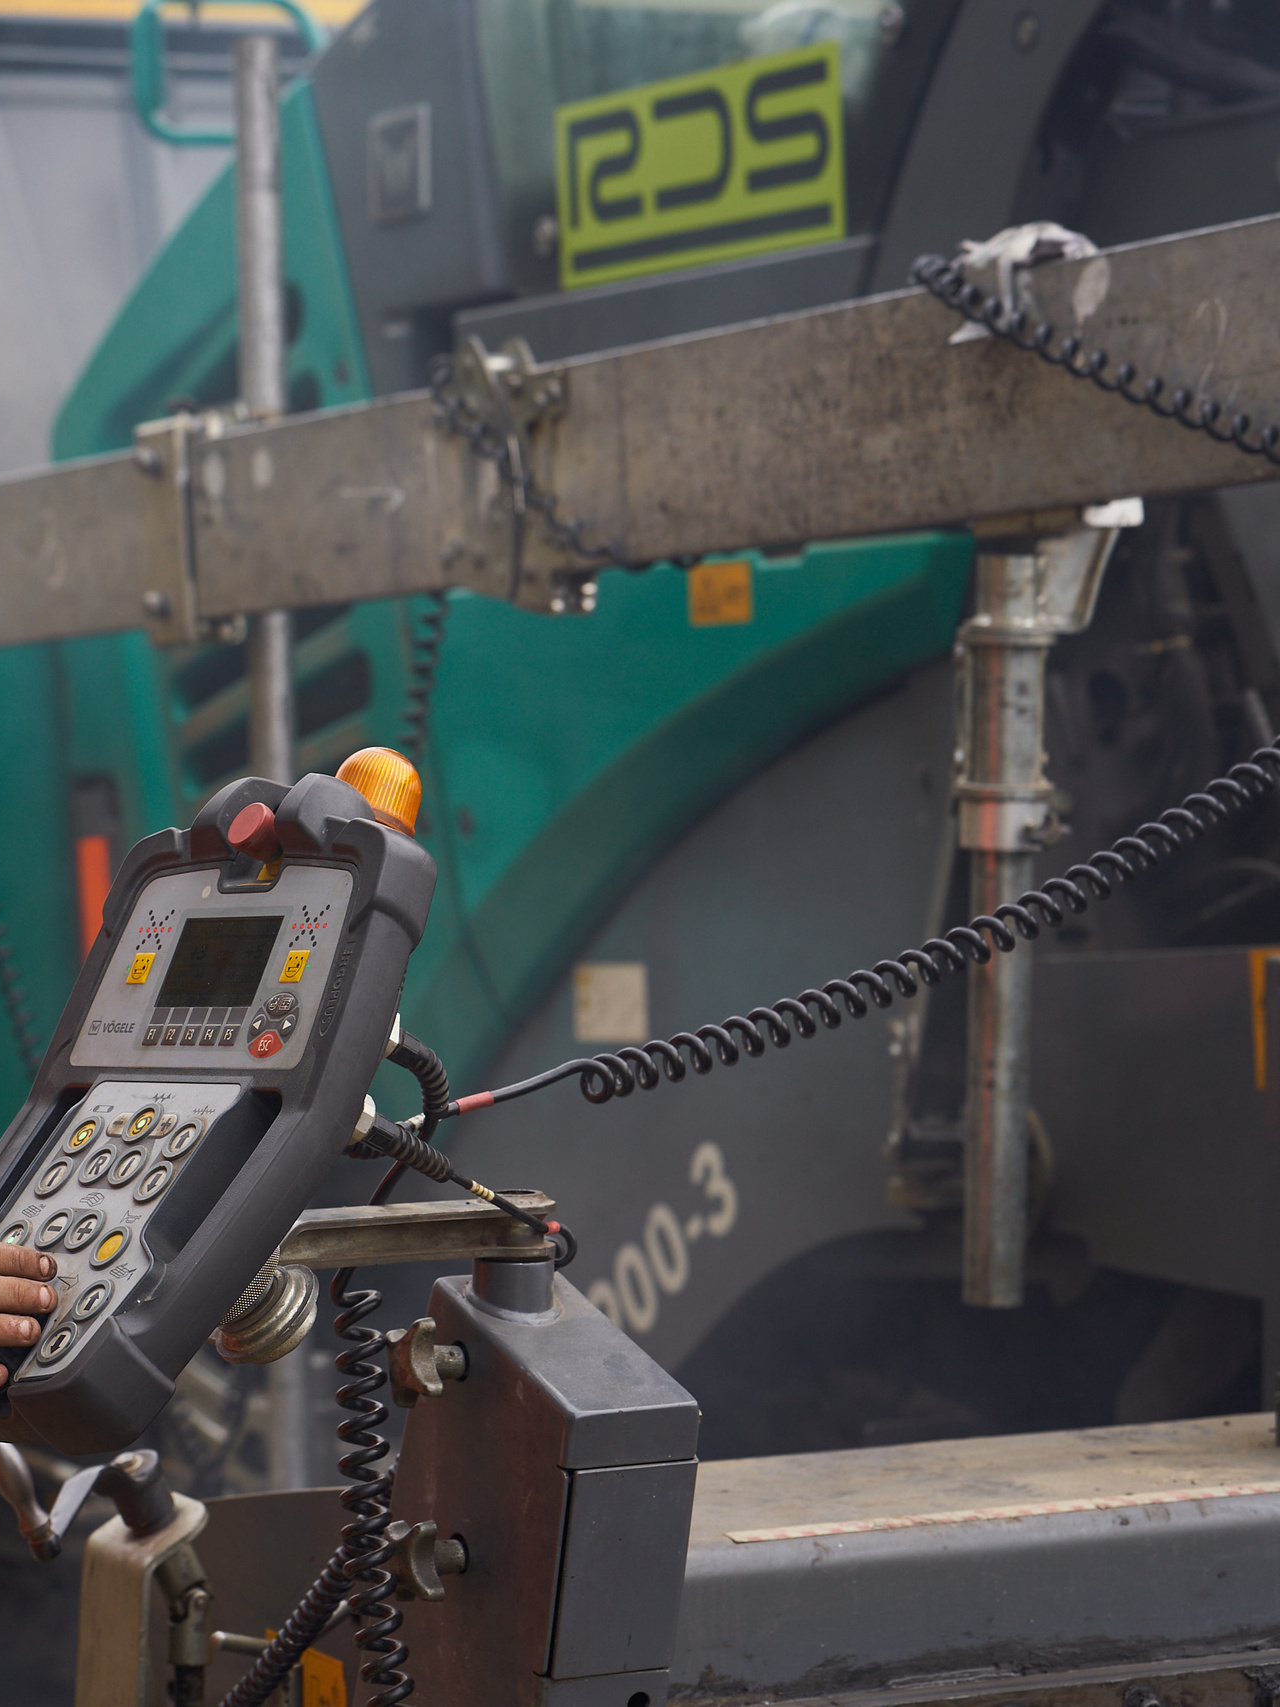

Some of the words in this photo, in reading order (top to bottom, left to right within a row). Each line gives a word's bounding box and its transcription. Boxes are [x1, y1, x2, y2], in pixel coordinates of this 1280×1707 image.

[568, 58, 830, 230] RDS
[102, 1020, 135, 1034] VÖGELE
[147, 1028, 157, 1040] F1
[166, 1028, 175, 1040] F2
[185, 1028, 194, 1040] F3
[204, 1028, 214, 1040] F4
[224, 1028, 234, 1040] F5
[257, 1039, 272, 1052] ESC
[88, 1156, 108, 1175] R
